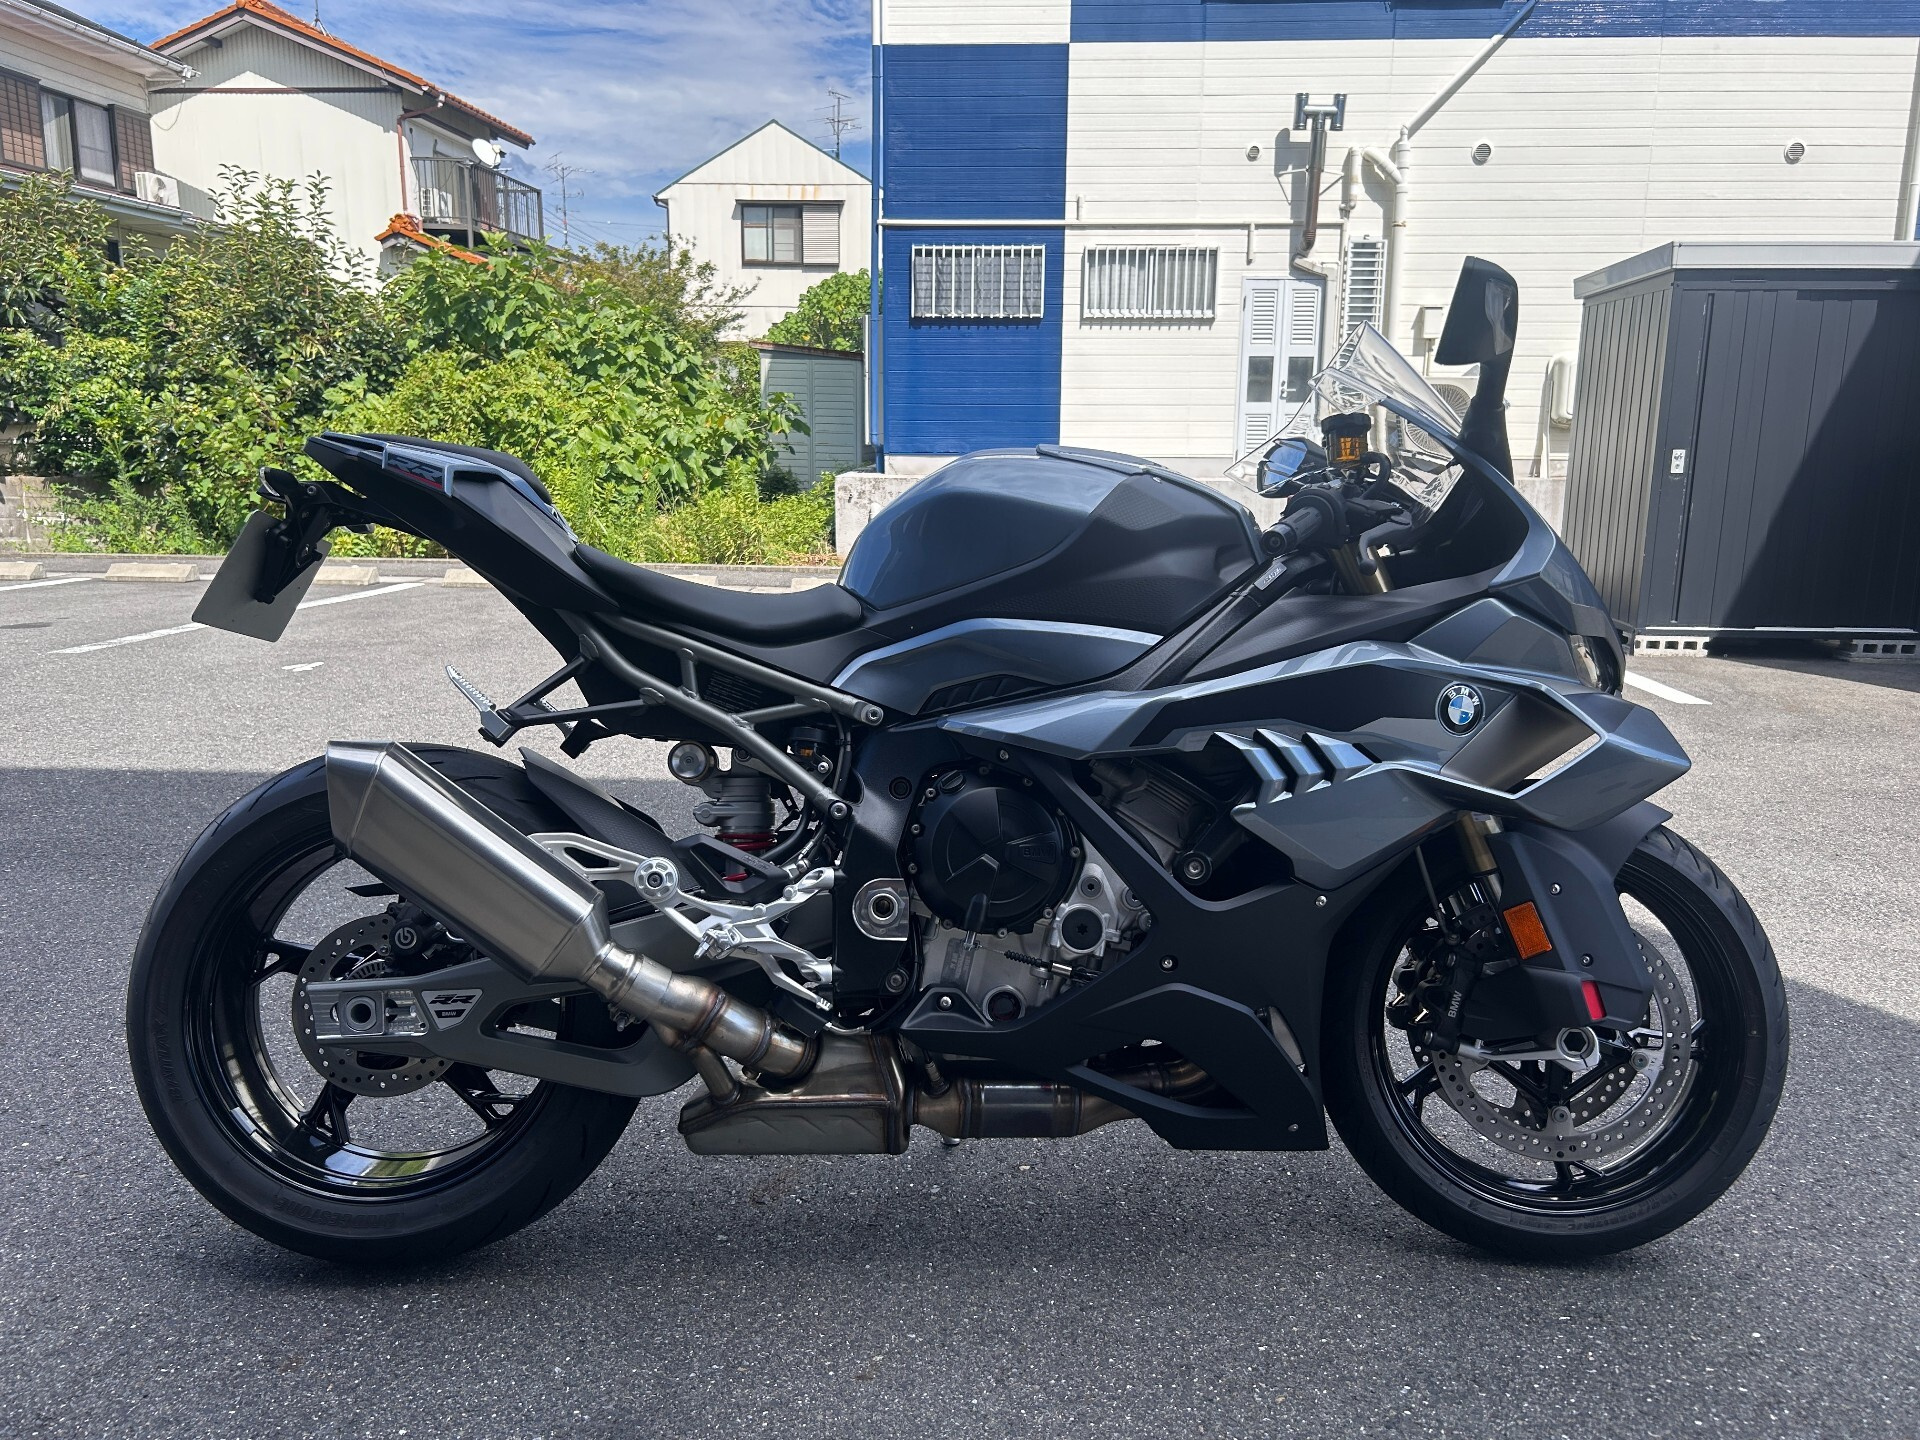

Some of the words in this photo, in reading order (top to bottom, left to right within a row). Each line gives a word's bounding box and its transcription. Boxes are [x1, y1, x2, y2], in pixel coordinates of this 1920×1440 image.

[1447, 687, 1480, 706] BMW
[429, 993, 476, 1005] RR
[1448, 990, 1462, 1018] BMW
